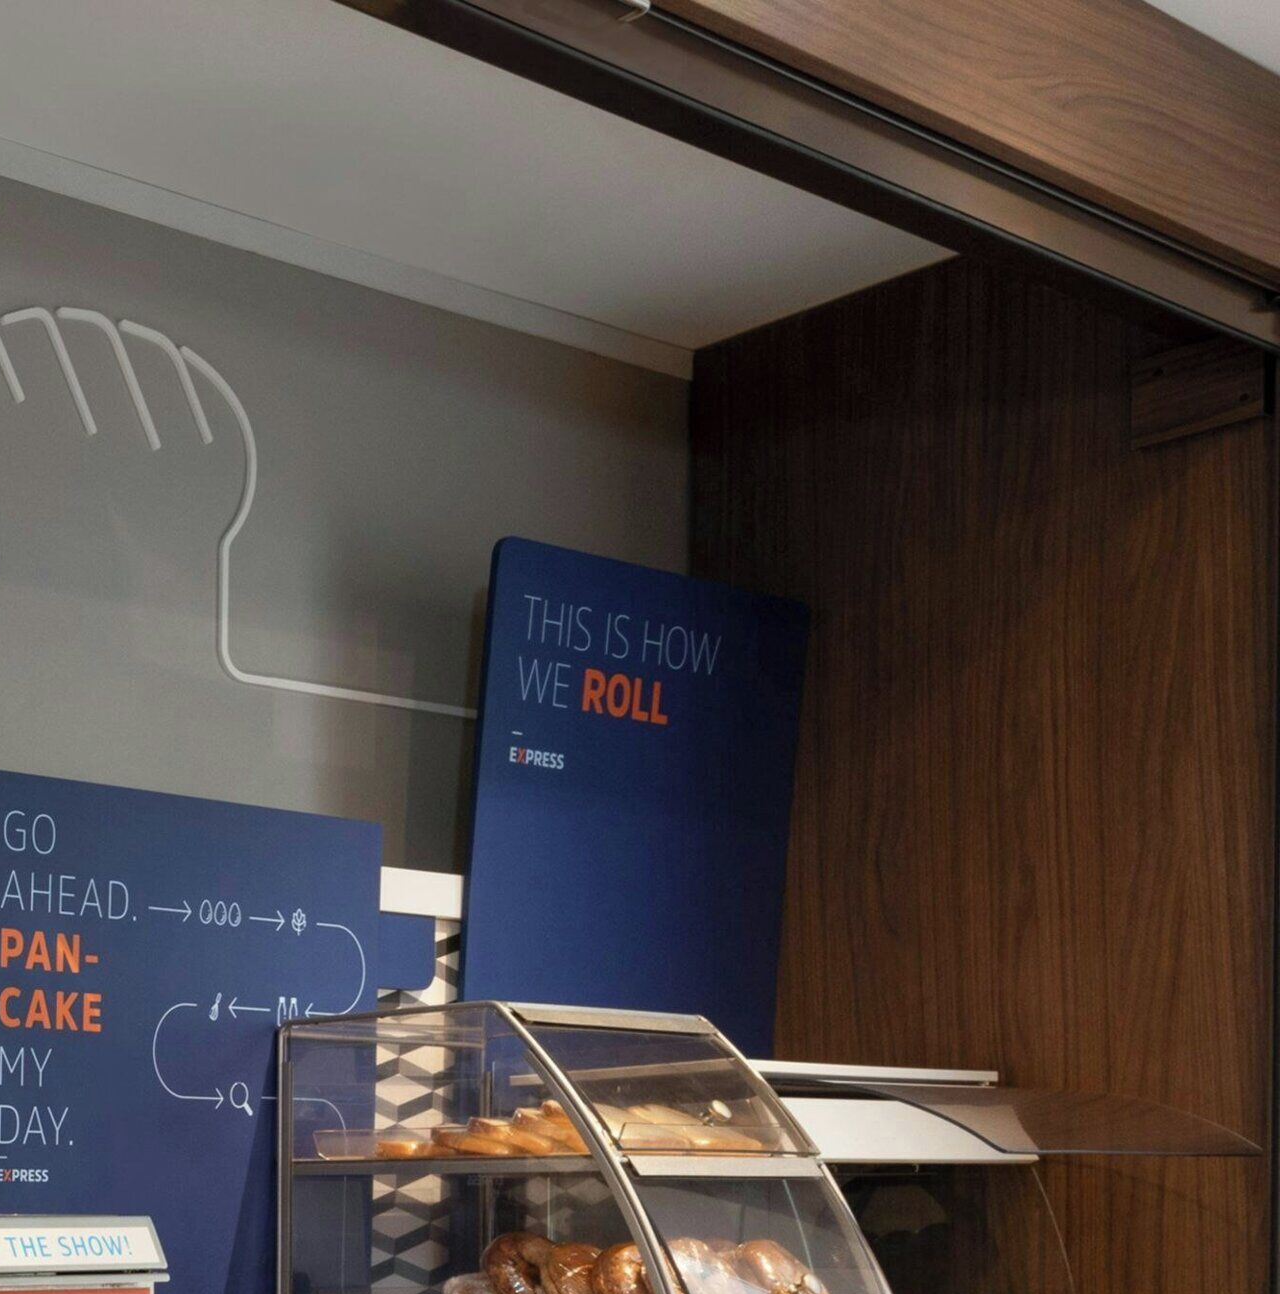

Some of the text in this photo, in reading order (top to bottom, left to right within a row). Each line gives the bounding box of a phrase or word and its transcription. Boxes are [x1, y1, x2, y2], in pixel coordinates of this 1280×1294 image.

[524, 594, 722, 675] THIS IS HOW
[518, 656, 668, 725] WE ROLL
[509, 746, 564, 770] EXPRESS
[3, 810, 56, 854] GO
[0, 870, 138, 922] AHEAD.
[0, 928, 99, 973] PAN-
[5, 1236, 51, 1257] THE
[58, 1235, 133, 1257] SHOW!
